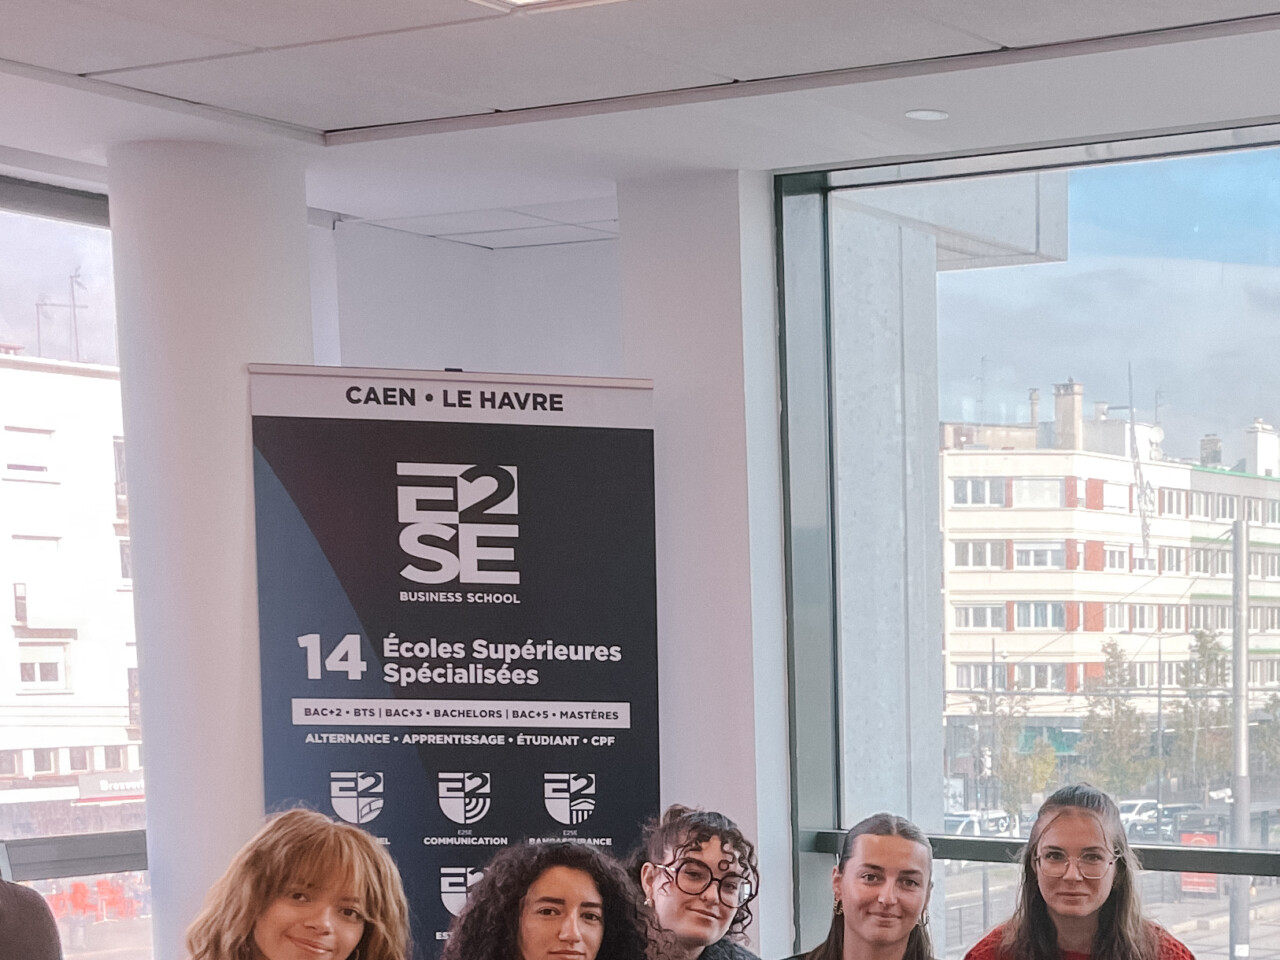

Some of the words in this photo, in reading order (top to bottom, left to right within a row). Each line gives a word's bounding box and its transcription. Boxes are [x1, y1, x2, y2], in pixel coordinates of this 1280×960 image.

[345, 386, 416, 406] CAEN
[443, 389, 472, 408] LE
[479, 390, 564, 412] HAVRE
[400, 591, 462, 603] BUSINESS
[467, 593, 521, 604] SCHOOL
[297, 633, 367, 681] 14
[383, 633, 465, 660] Écoles
[472, 639, 622, 663] Supérieures
[383, 663, 539, 686] Spécialisées
[304, 707, 342, 717] BAC+2
[354, 708, 375, 717] BTS
[385, 708, 423, 718] BAC+3
[434, 709, 502, 719] BACHELORS
[512, 710, 549, 719] BAC+5
[305, 733, 390, 744] ALTERNANCE
[402, 734, 505, 745] APPRENTISSAGE
[517, 733, 579, 746] ÉTUDIANT
[591, 736, 616, 746] CPF
[423, 837, 508, 846] COMMUNICATION
